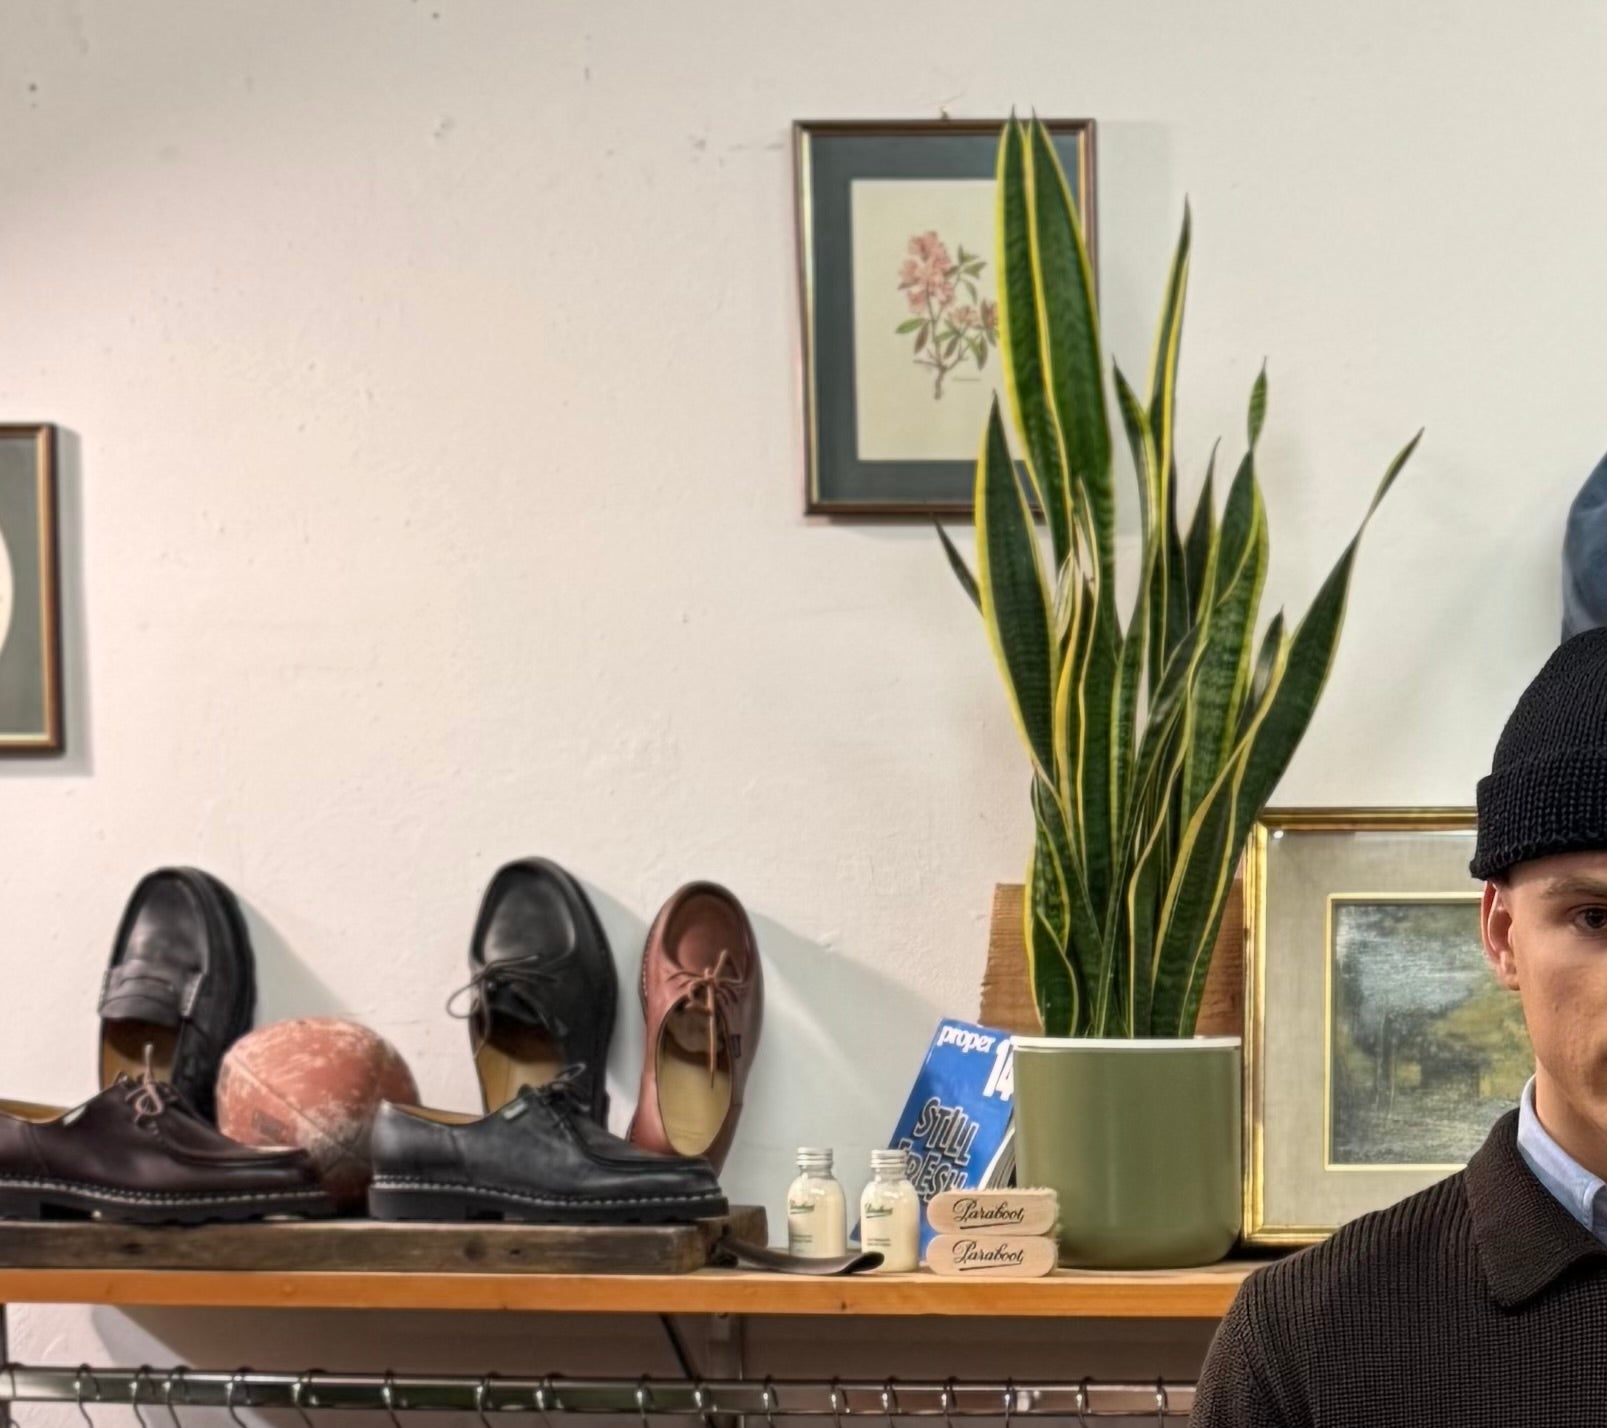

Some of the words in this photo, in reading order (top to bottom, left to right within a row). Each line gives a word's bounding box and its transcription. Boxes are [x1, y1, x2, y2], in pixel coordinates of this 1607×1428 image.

[937, 1026, 997, 1053] proper
[983, 1039, 1014, 1101] 14
[913, 1096, 979, 1166] STILL
[952, 1198, 1024, 1227] Paraboot
[952, 1239, 1024, 1269] Paraboot
